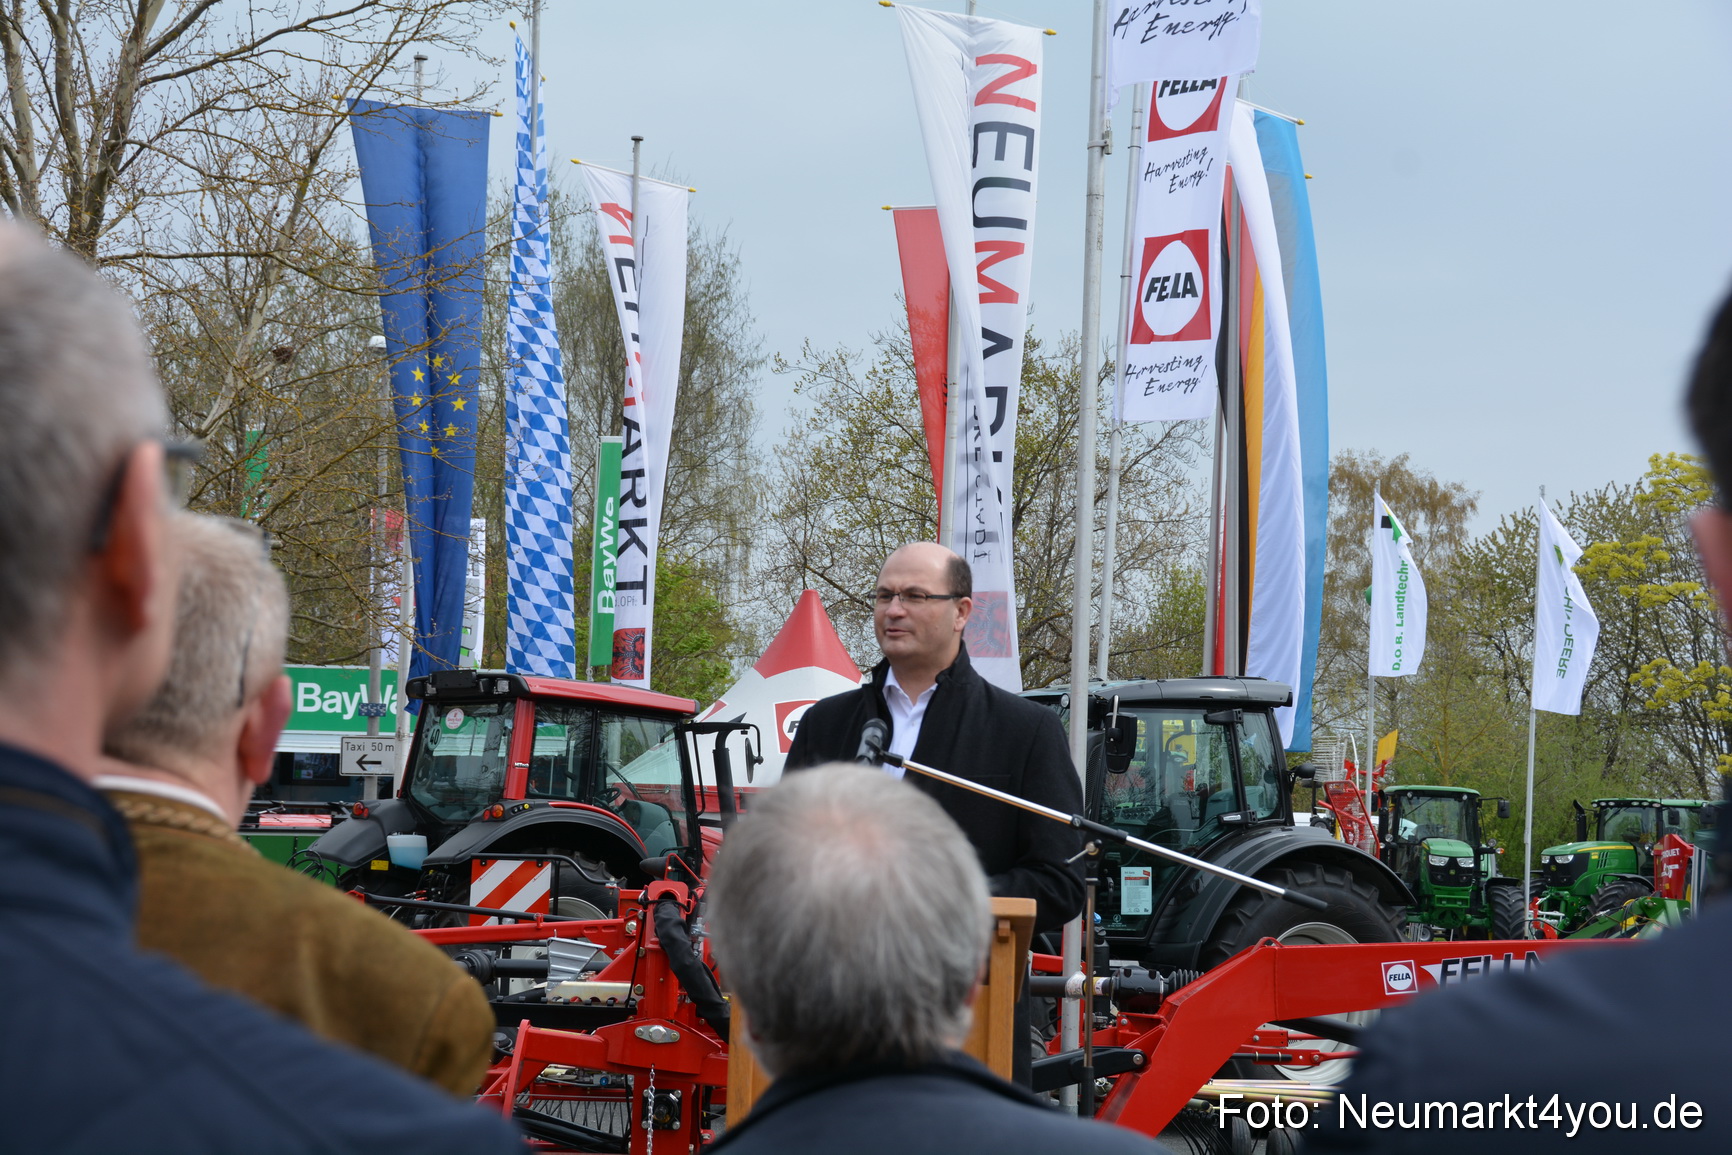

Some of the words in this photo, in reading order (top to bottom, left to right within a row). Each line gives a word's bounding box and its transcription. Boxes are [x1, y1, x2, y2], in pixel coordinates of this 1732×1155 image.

[1144, 147, 1208, 182] Harvesting
[597, 496, 617, 614] BayWa
[430, 729, 441, 746] 40
[345, 742, 365, 752] Taxi
[371, 742, 383, 752] 50
[385, 744, 395, 752] m
[1389, 972, 1412, 982] FELLA
